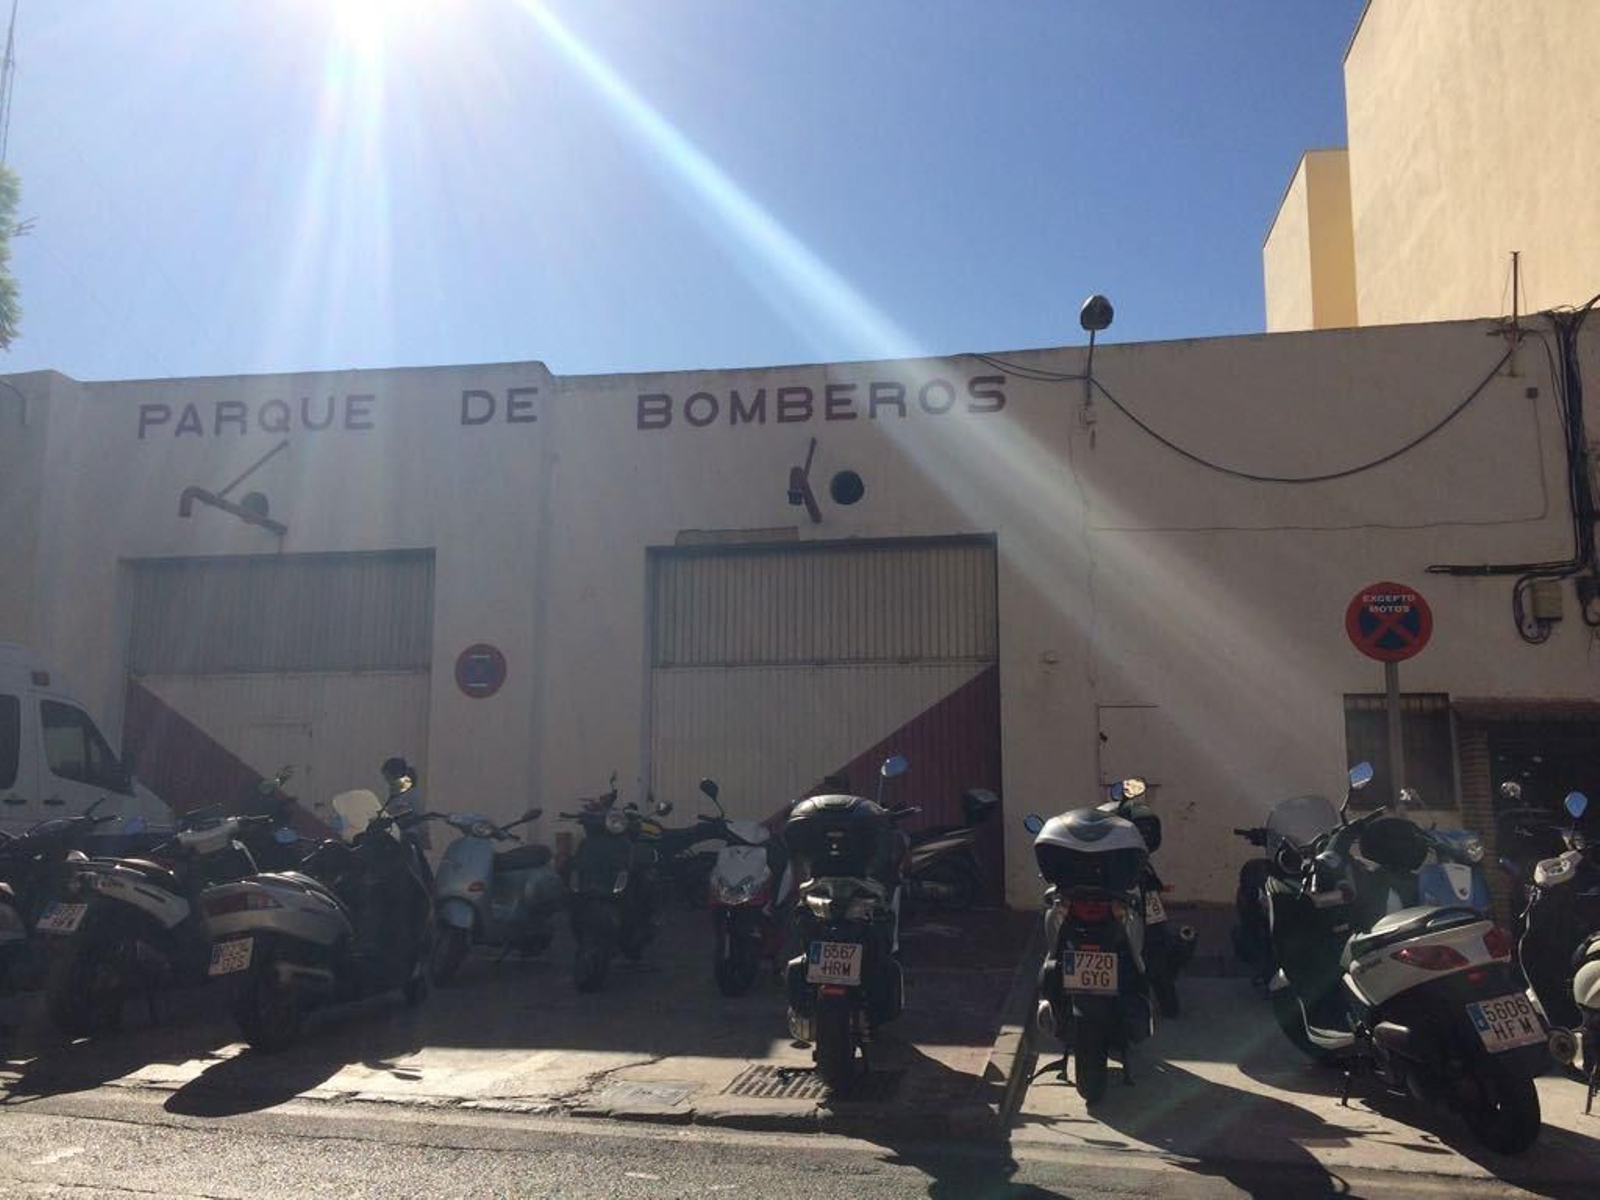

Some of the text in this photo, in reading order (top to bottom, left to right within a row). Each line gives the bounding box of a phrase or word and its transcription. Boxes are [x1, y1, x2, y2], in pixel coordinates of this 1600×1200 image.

[136, 375, 1008, 439] PARQUE DE BOMBEROS
[1362, 594, 1415, 603] EXCEPTO
[1369, 605, 1410, 613] MOTOS
[823, 960, 851, 976] HRM
[1075, 953, 1113, 971] 7720
[1081, 970, 1111, 987] GYG
